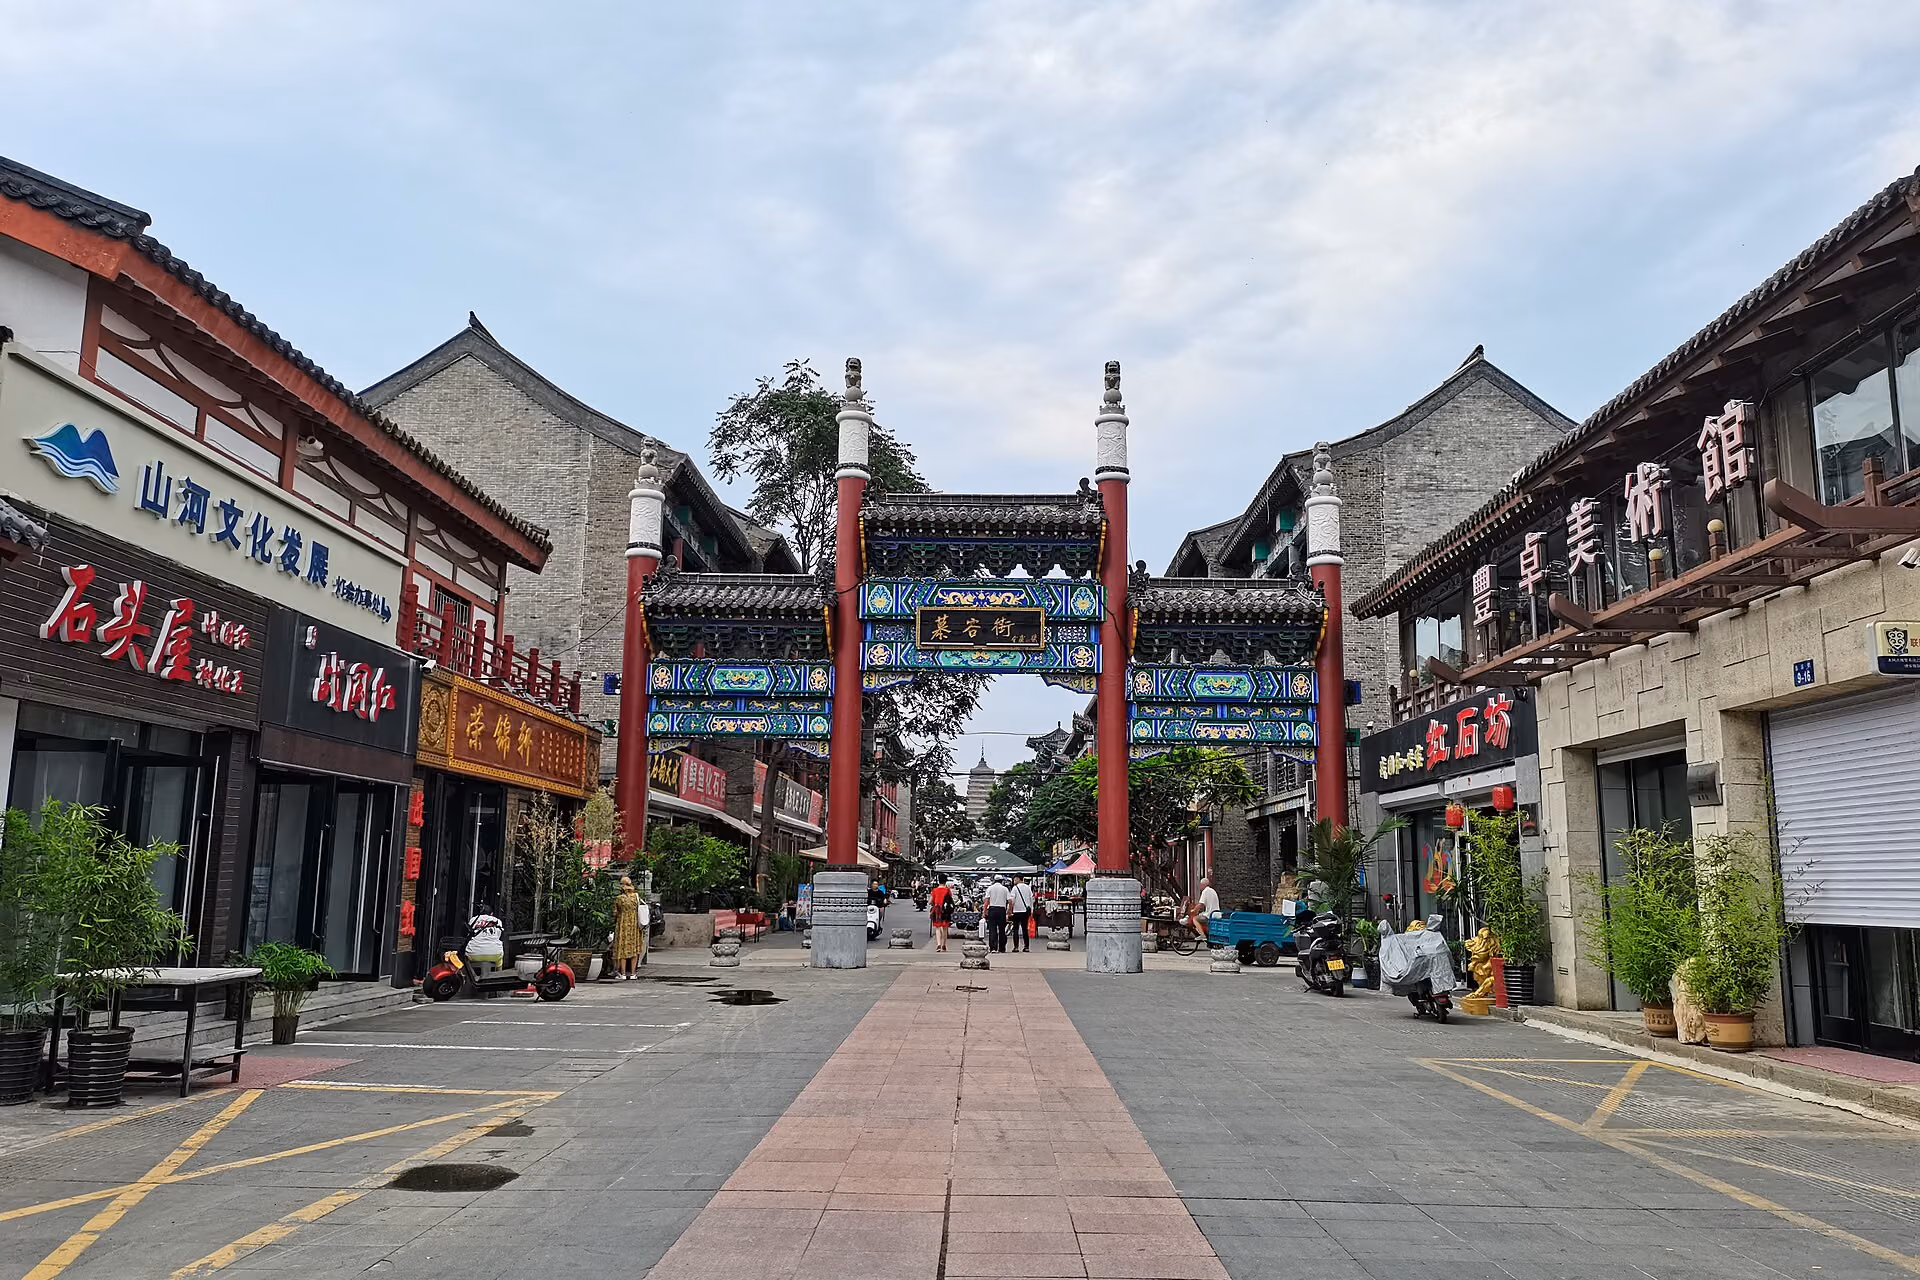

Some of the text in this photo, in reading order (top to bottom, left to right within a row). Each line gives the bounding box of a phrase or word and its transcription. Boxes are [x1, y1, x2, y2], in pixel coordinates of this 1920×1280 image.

[135, 460, 330, 588] 山河文化发展
[1472, 399, 1752, 628] 豐卓美術館
[39, 564, 194, 681] 石头屋
[930, 613, 1015, 640] 慕容街
[1796, 670, 1812, 684] 9-16
[1425, 692, 1514, 772] 红石坊
